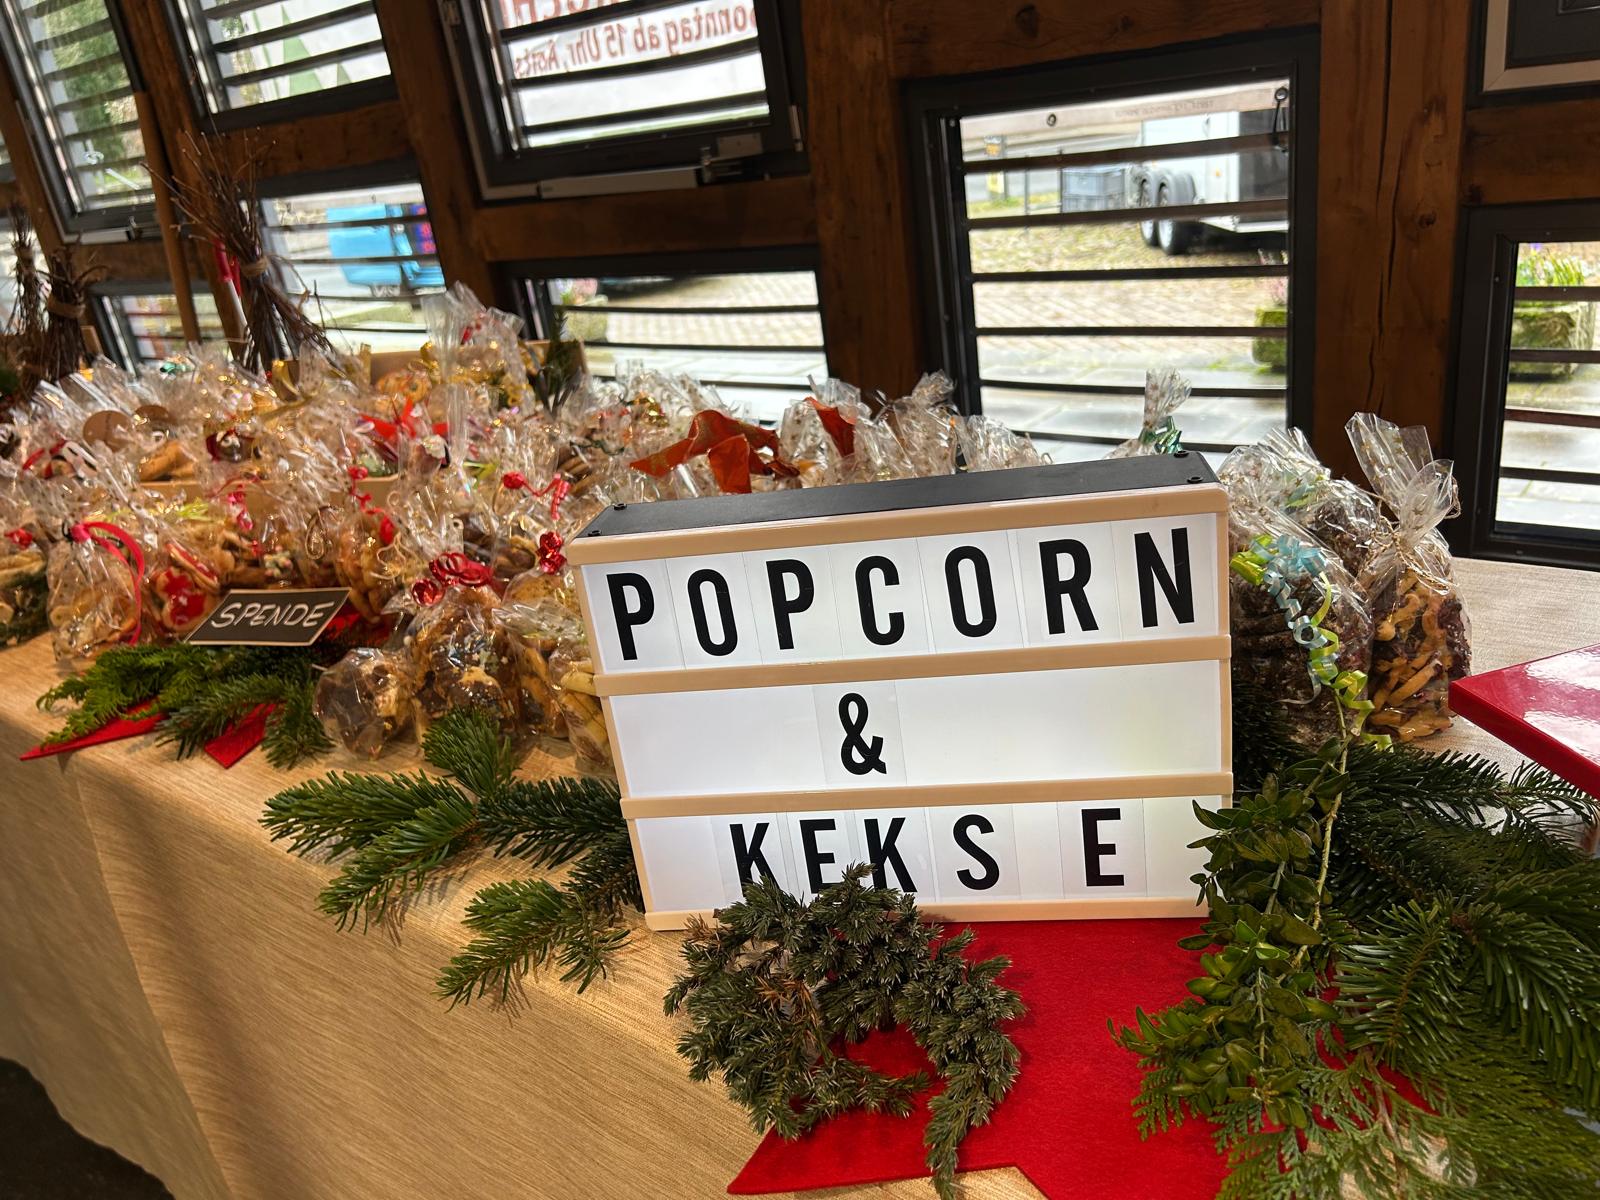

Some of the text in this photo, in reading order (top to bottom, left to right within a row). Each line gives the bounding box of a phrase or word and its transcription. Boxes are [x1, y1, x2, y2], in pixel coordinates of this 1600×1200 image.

[210, 601, 335, 628] SPENDE
[606, 527, 1195, 661] POPCORN
[838, 692, 887, 775] &
